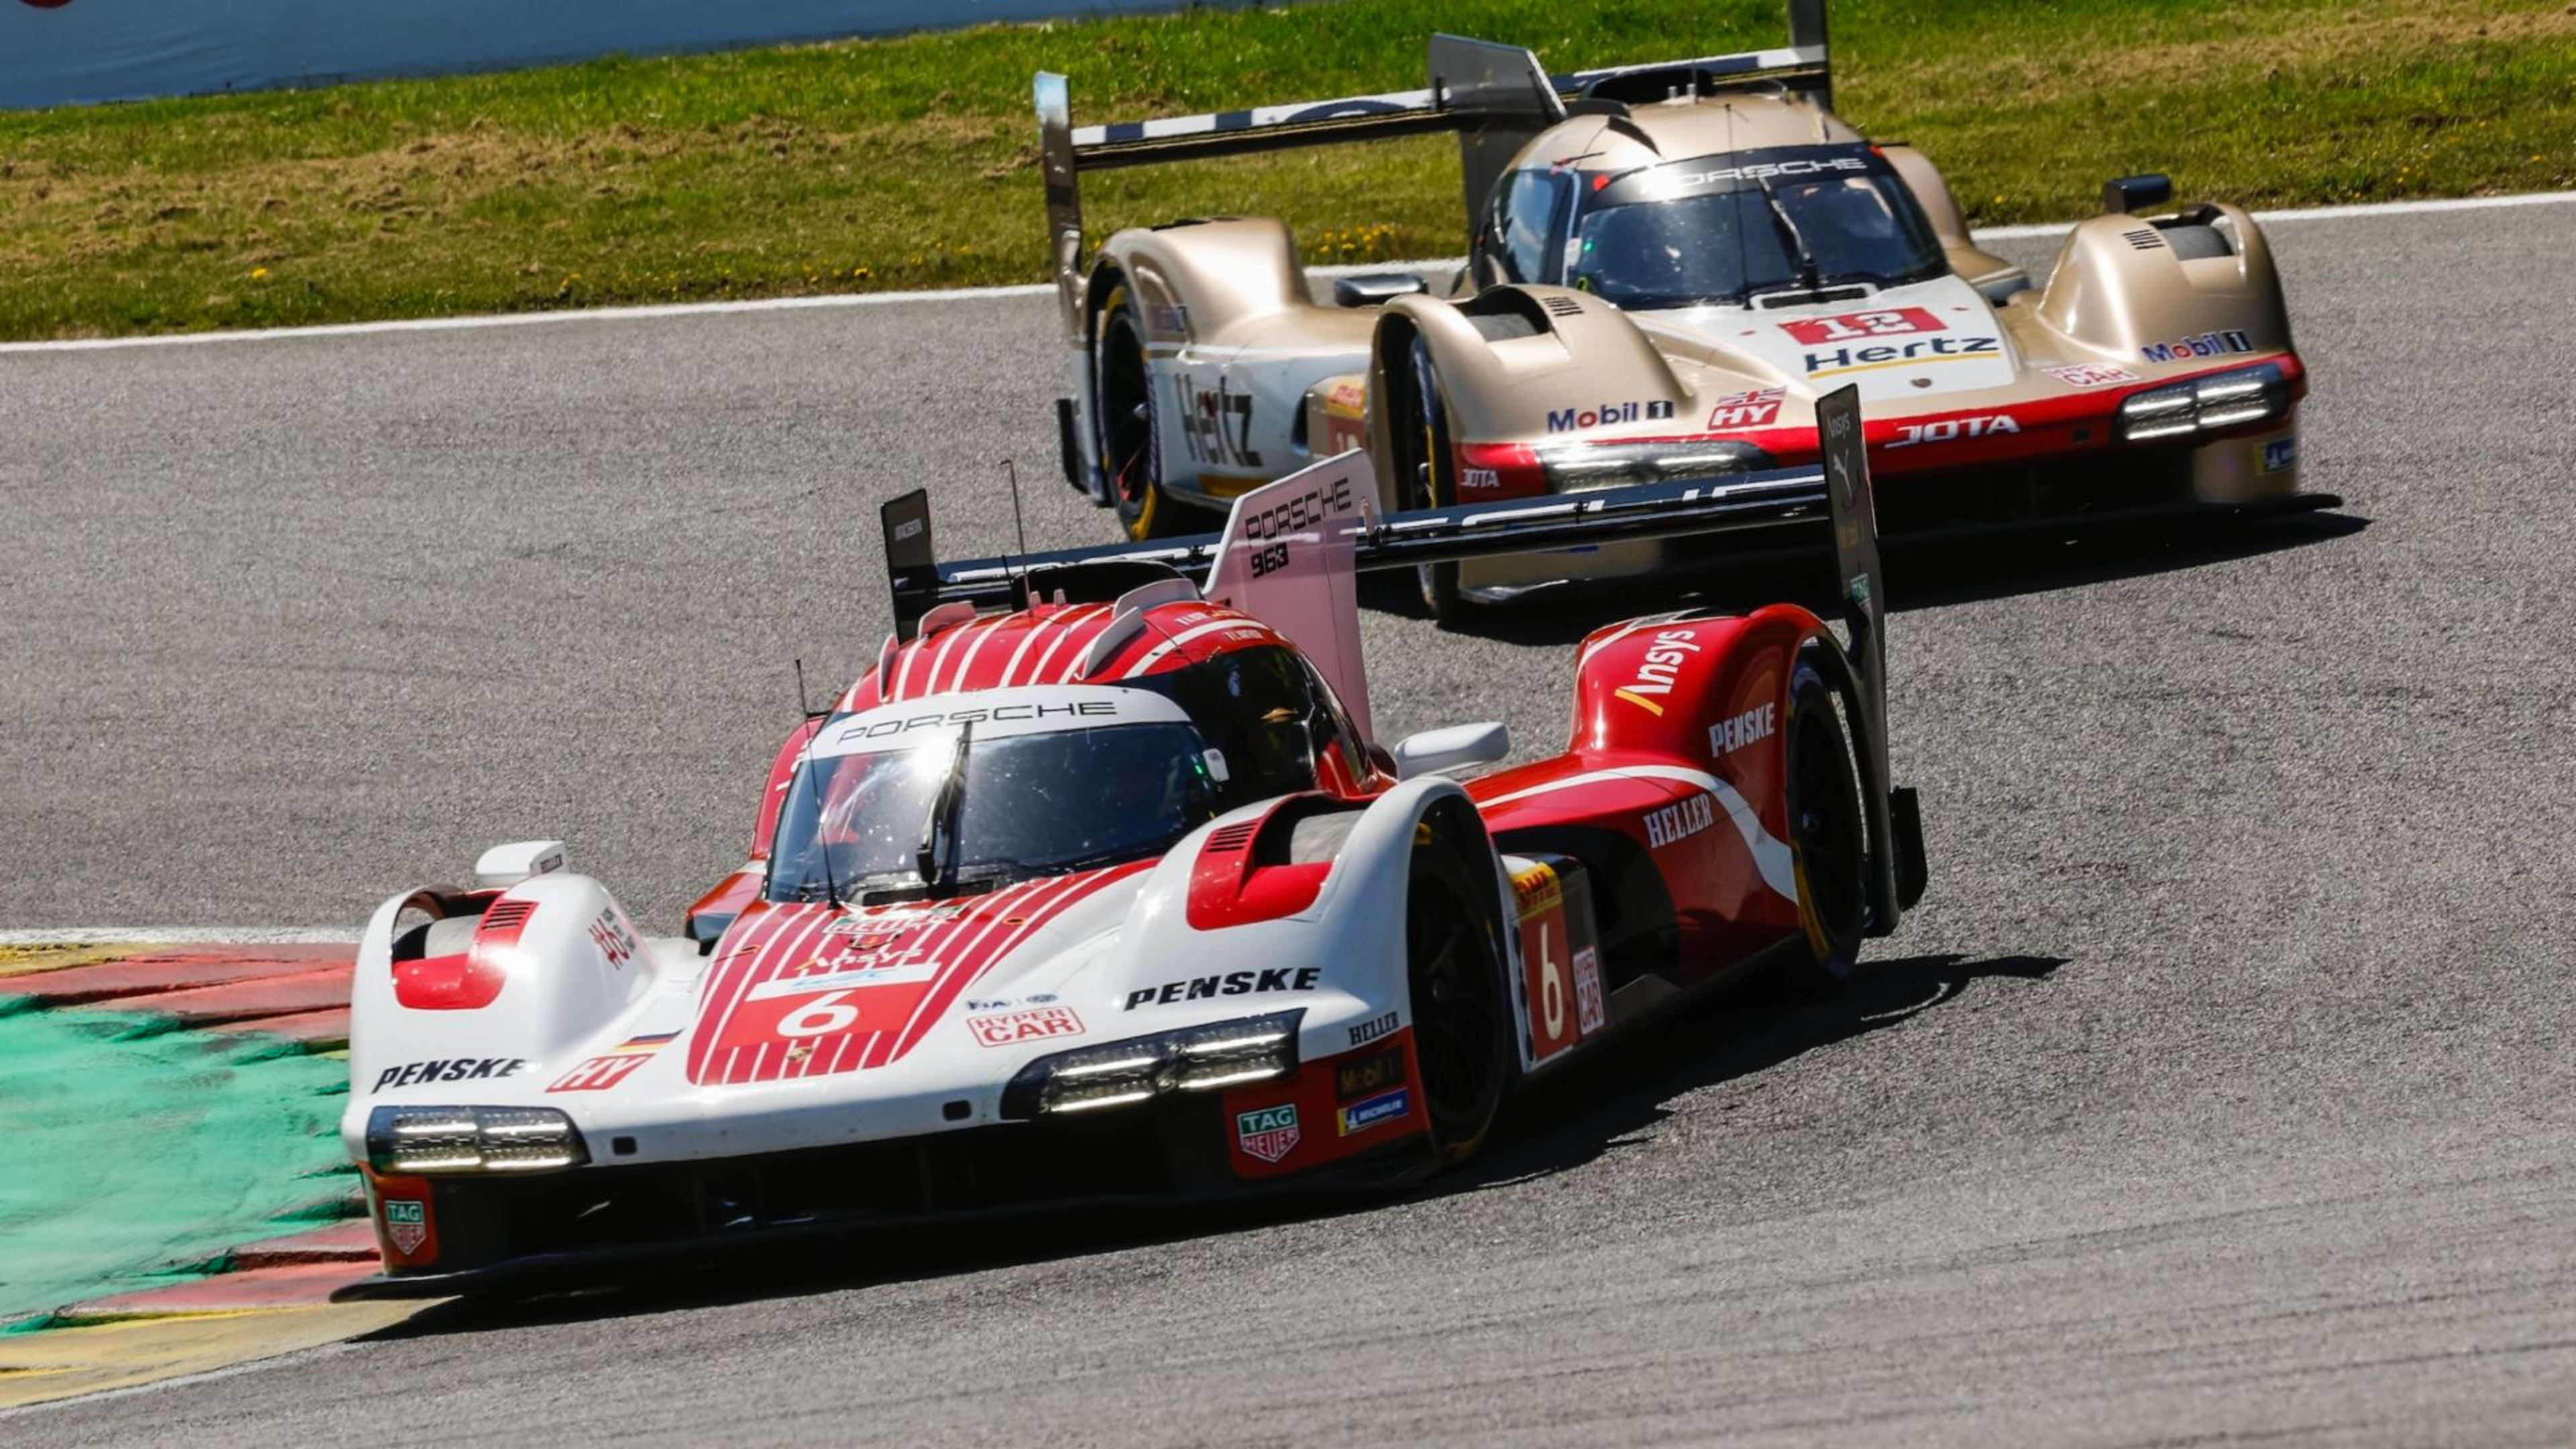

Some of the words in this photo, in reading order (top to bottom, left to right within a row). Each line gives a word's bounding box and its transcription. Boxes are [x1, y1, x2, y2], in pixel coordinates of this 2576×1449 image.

[1805, 337, 1998, 372] Hertz
[2142, 333, 2226, 362] Mobil
[1547, 402, 1638, 433] Mobil
[1710, 402, 1776, 427] HY
[1884, 415, 2021, 448] JOTA
[1245, 478, 1351, 549] PORSCHE
[1251, 542, 1289, 579] 963
[1614, 631, 1701, 717] Ansys
[837, 702, 1117, 743] PORSCHE
[1709, 702, 1774, 758] PENSKE
[1643, 793, 1713, 848] HELLER
[1124, 967, 1321, 1011] PENSKE
[1541, 922, 1564, 1040] 6
[776, 989, 859, 1037] 6
[975, 1009, 1067, 1028] HYPER
[983, 1018, 1075, 1042] CAR
[1348, 1011, 1399, 1044] HELLER
[371, 1059, 527, 1094] PENSKE
[550, 1055, 647, 1091] HY
[1243, 1109, 1292, 1132] TAG
[1244, 1128, 1297, 1159] HEUER
[387, 1205, 420, 1221] TAG
